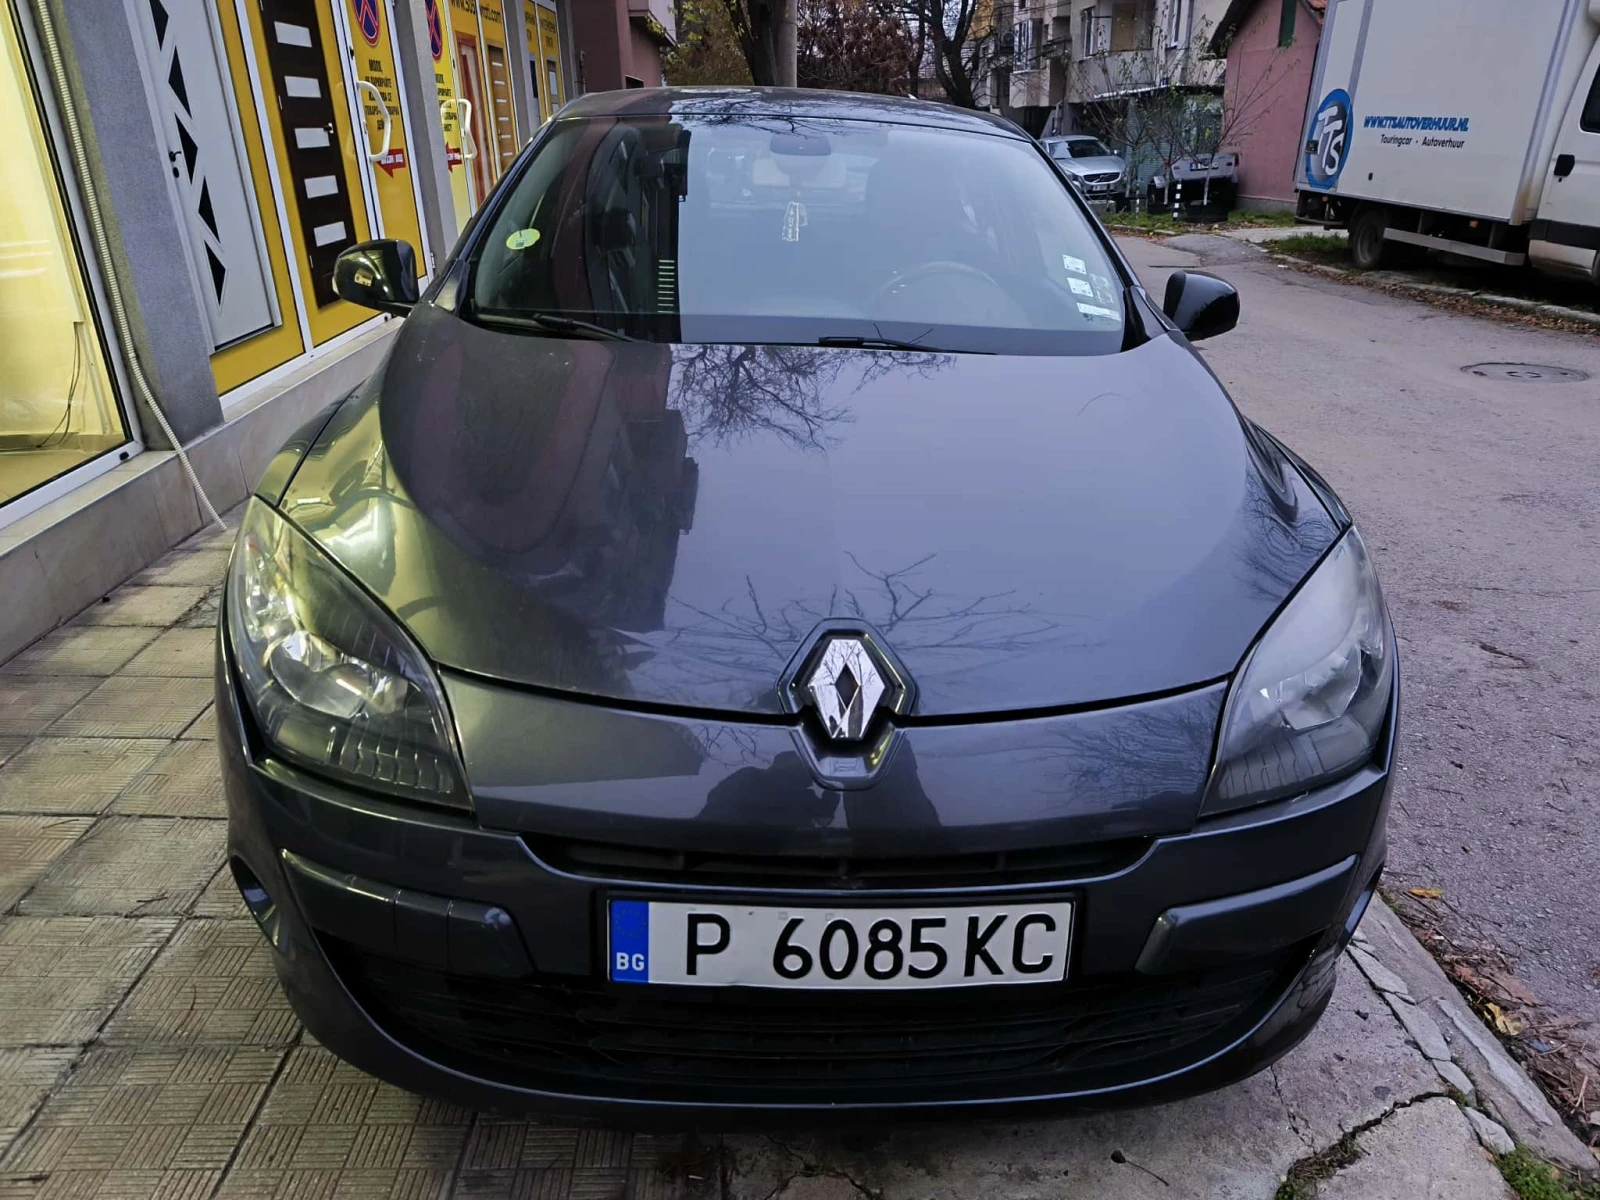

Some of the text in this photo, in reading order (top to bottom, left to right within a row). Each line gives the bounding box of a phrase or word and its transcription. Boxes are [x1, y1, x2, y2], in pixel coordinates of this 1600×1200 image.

[1363, 115, 1470, 131] WWW.TTSAUTOVERHUUR.NL
[1318, 105, 1345, 175] TTS
[1380, 134, 1465, 148] Touringcar Autoverhuur
[686, 913, 1056, 980] P 6085 KC
[616, 952, 645, 971] BG
